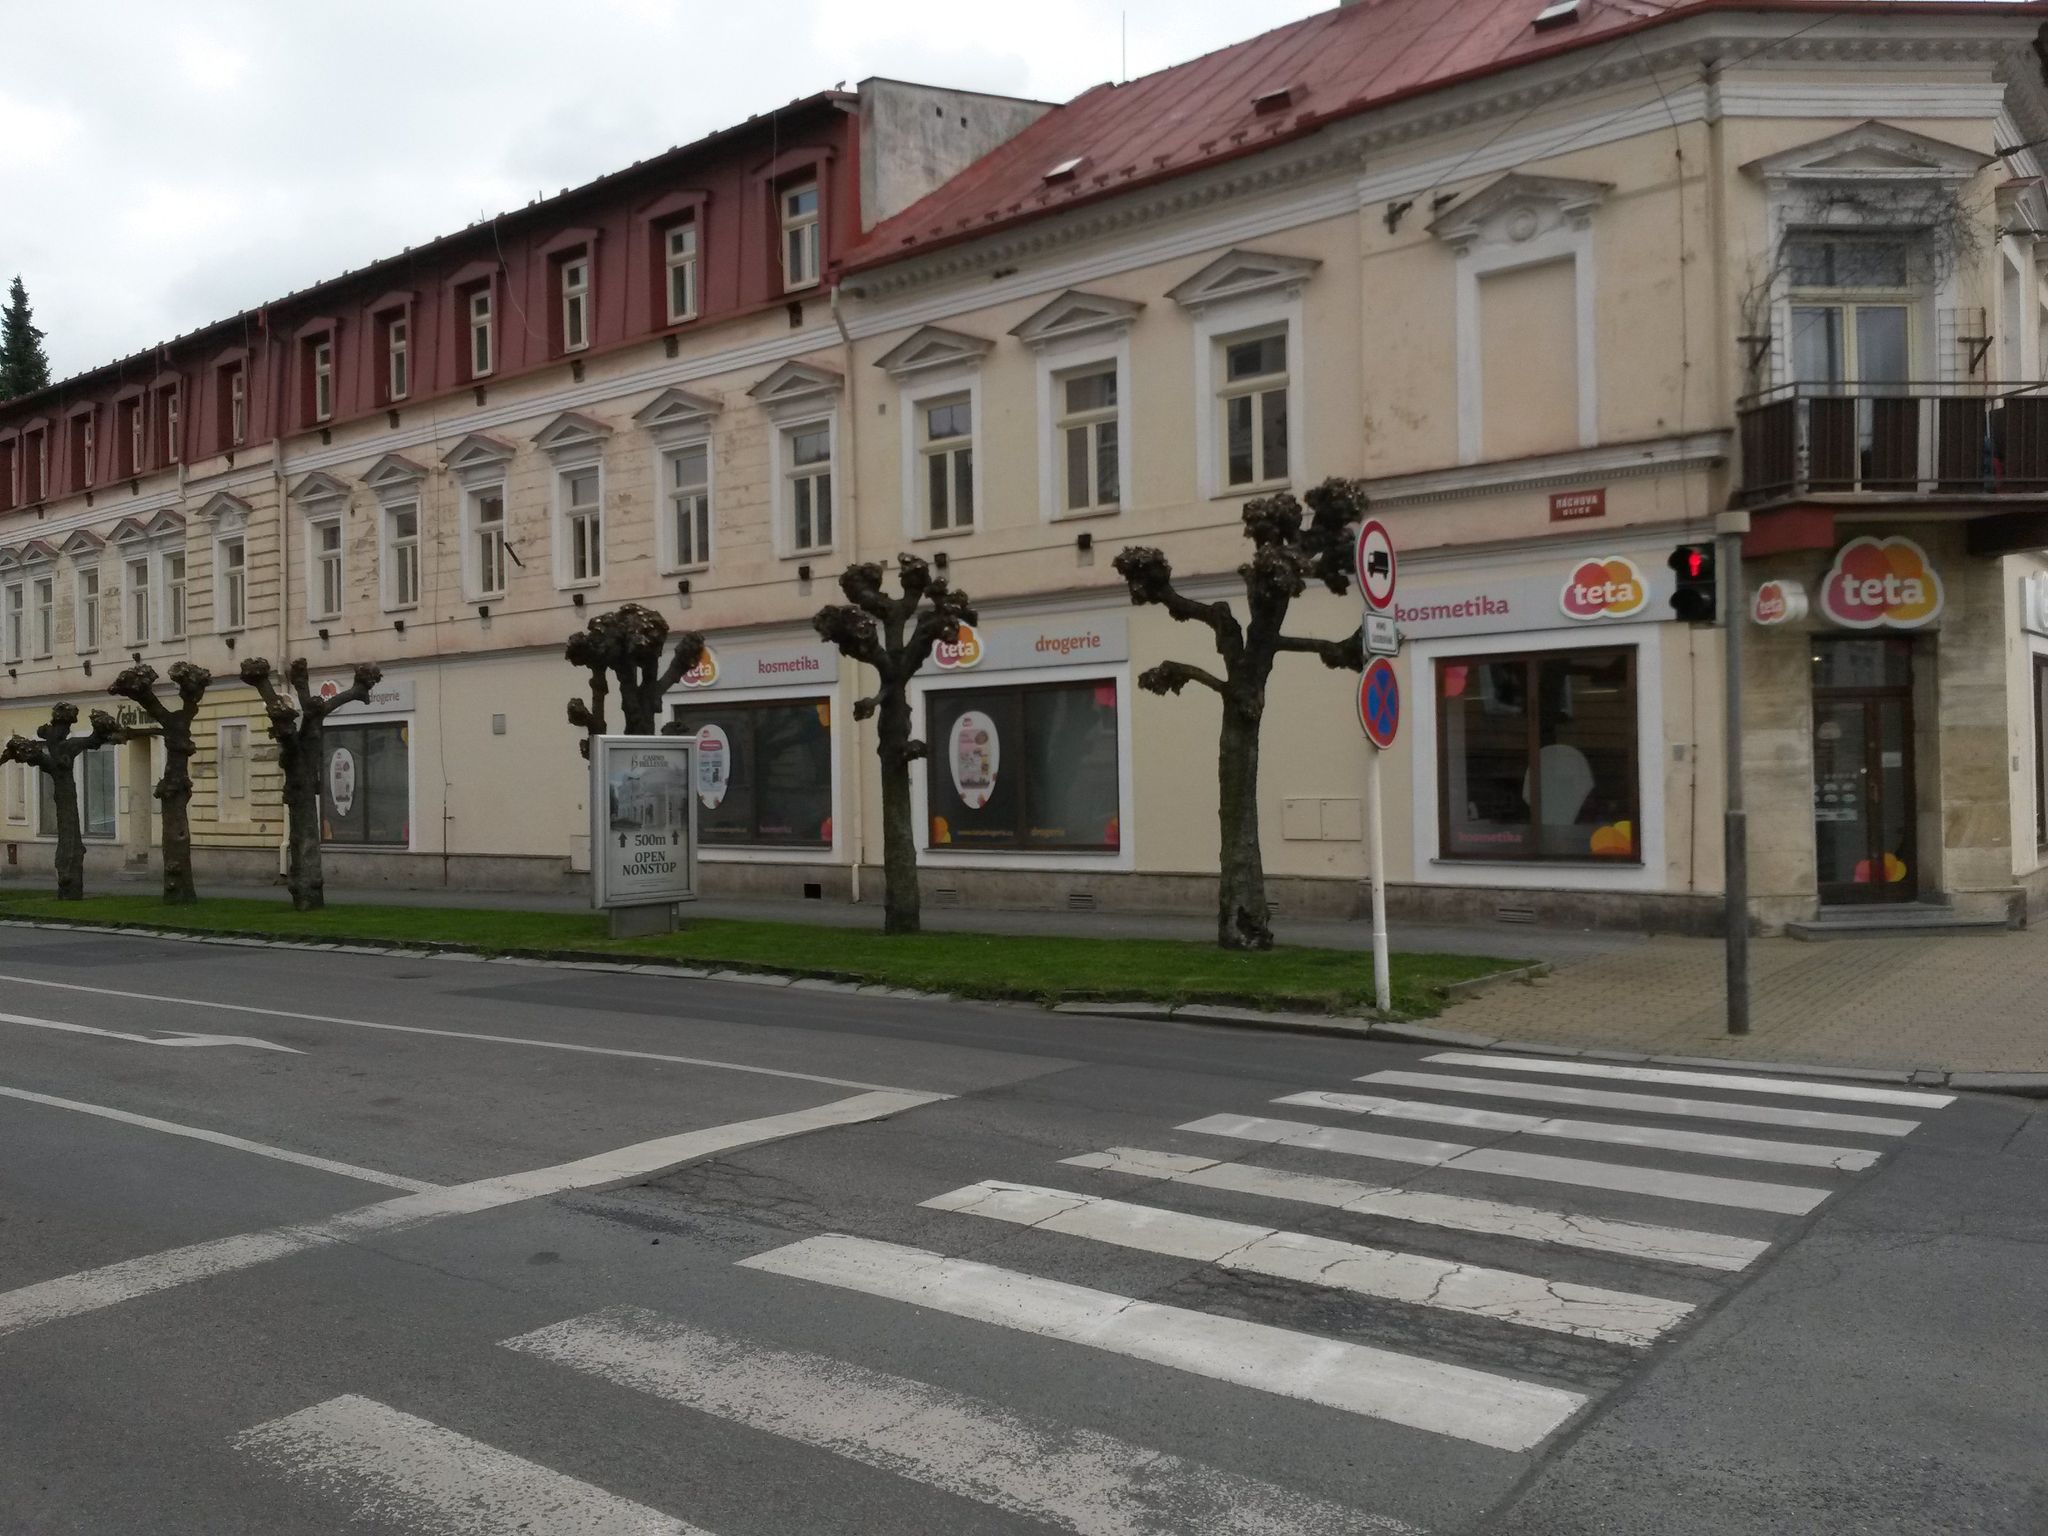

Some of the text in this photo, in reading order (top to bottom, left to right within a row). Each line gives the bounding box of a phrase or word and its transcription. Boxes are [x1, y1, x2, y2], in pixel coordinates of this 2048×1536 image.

[1573, 581, 1635, 606] teta
[1841, 573, 1927, 606] teta
[1394, 595, 1510, 623] kosmetika
[941, 639, 975, 659] teta
[1035, 632, 1101, 656] drogerie
[757, 656, 820, 674] kosmetika
[634, 834, 666, 847] 500m
[634, 850, 666, 863] OPEN
[622, 862, 677, 877] NONSTOP
